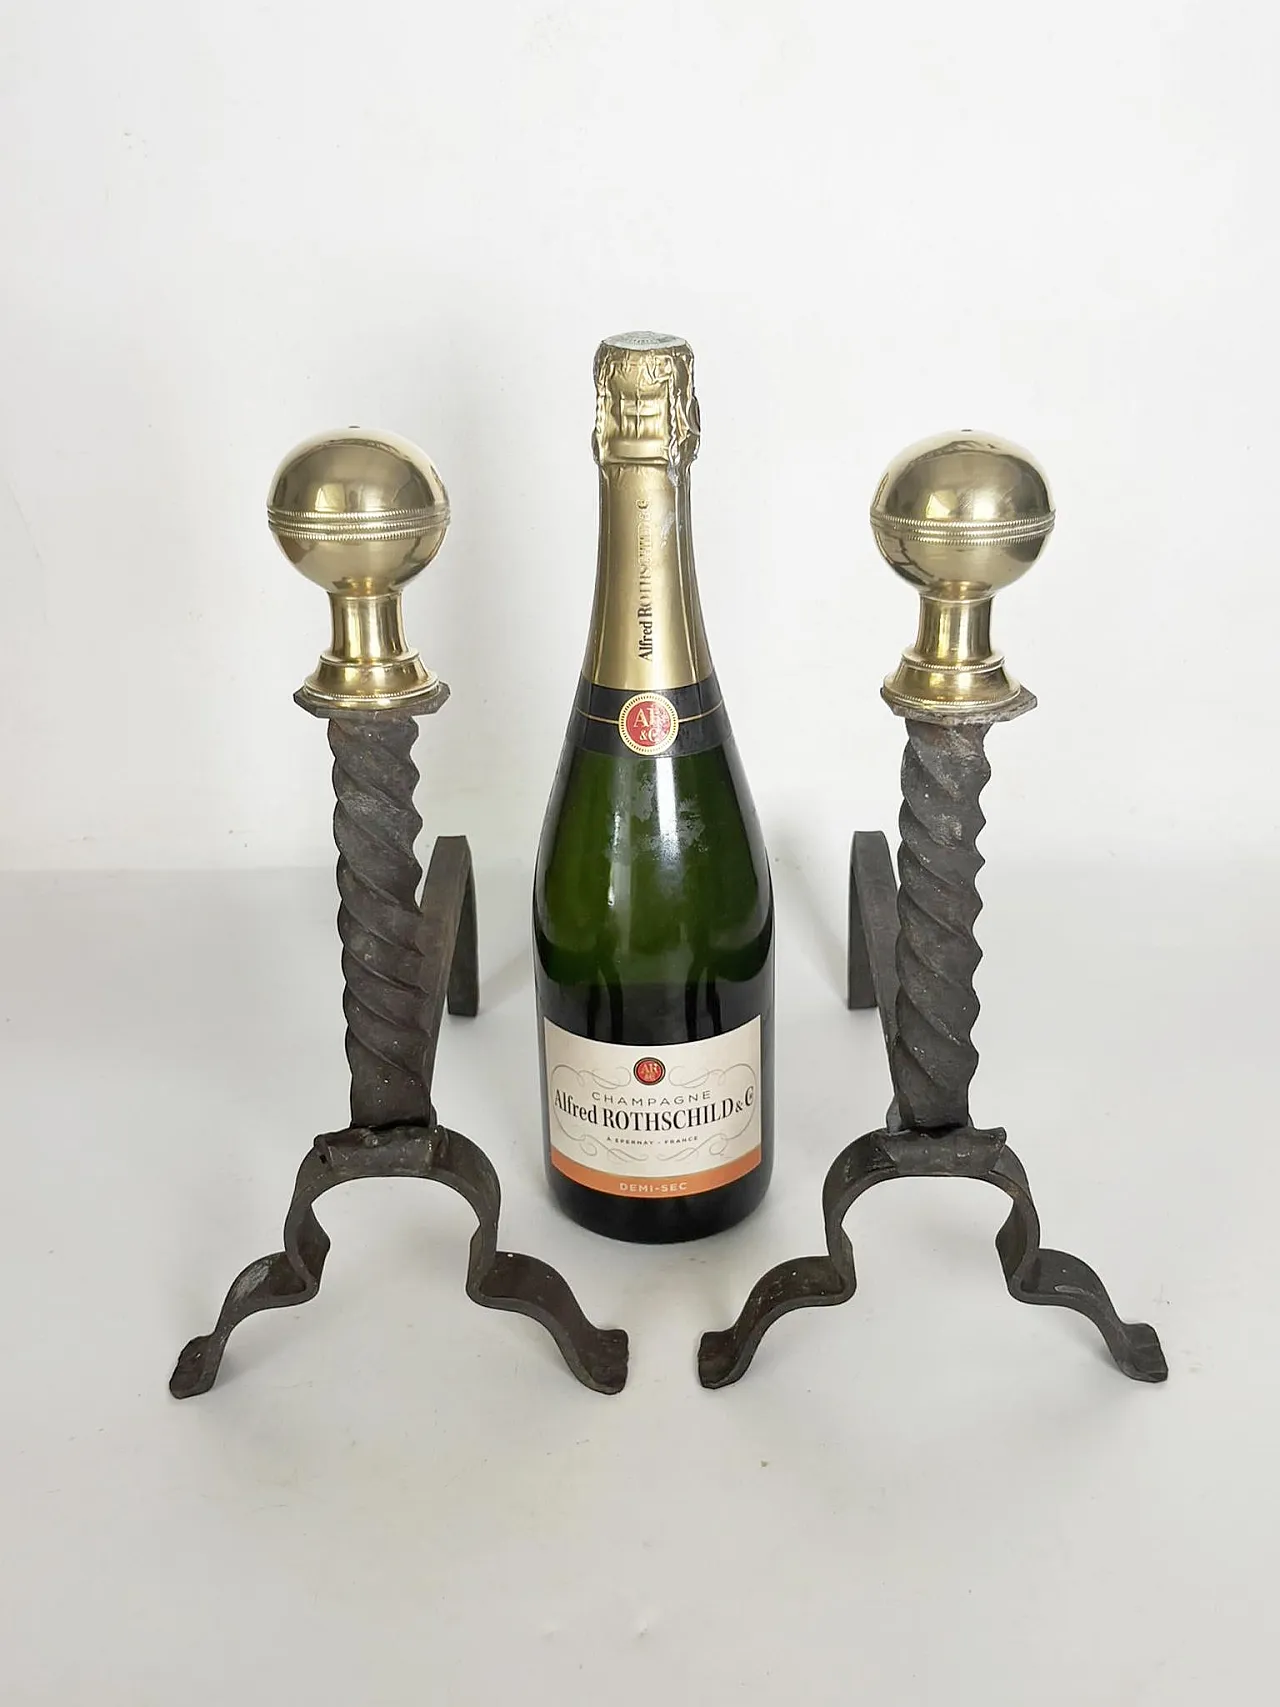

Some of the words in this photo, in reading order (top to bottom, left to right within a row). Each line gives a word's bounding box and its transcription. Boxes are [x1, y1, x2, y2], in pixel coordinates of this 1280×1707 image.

[638, 621, 653, 662] Alfred
[592, 1090, 711, 1106] CHAMPAGNE
[554, 1089, 598, 1125] Alfred
[664, 1136, 698, 1144] FRANCE
[619, 1182, 688, 1193] DEMI-SEC
